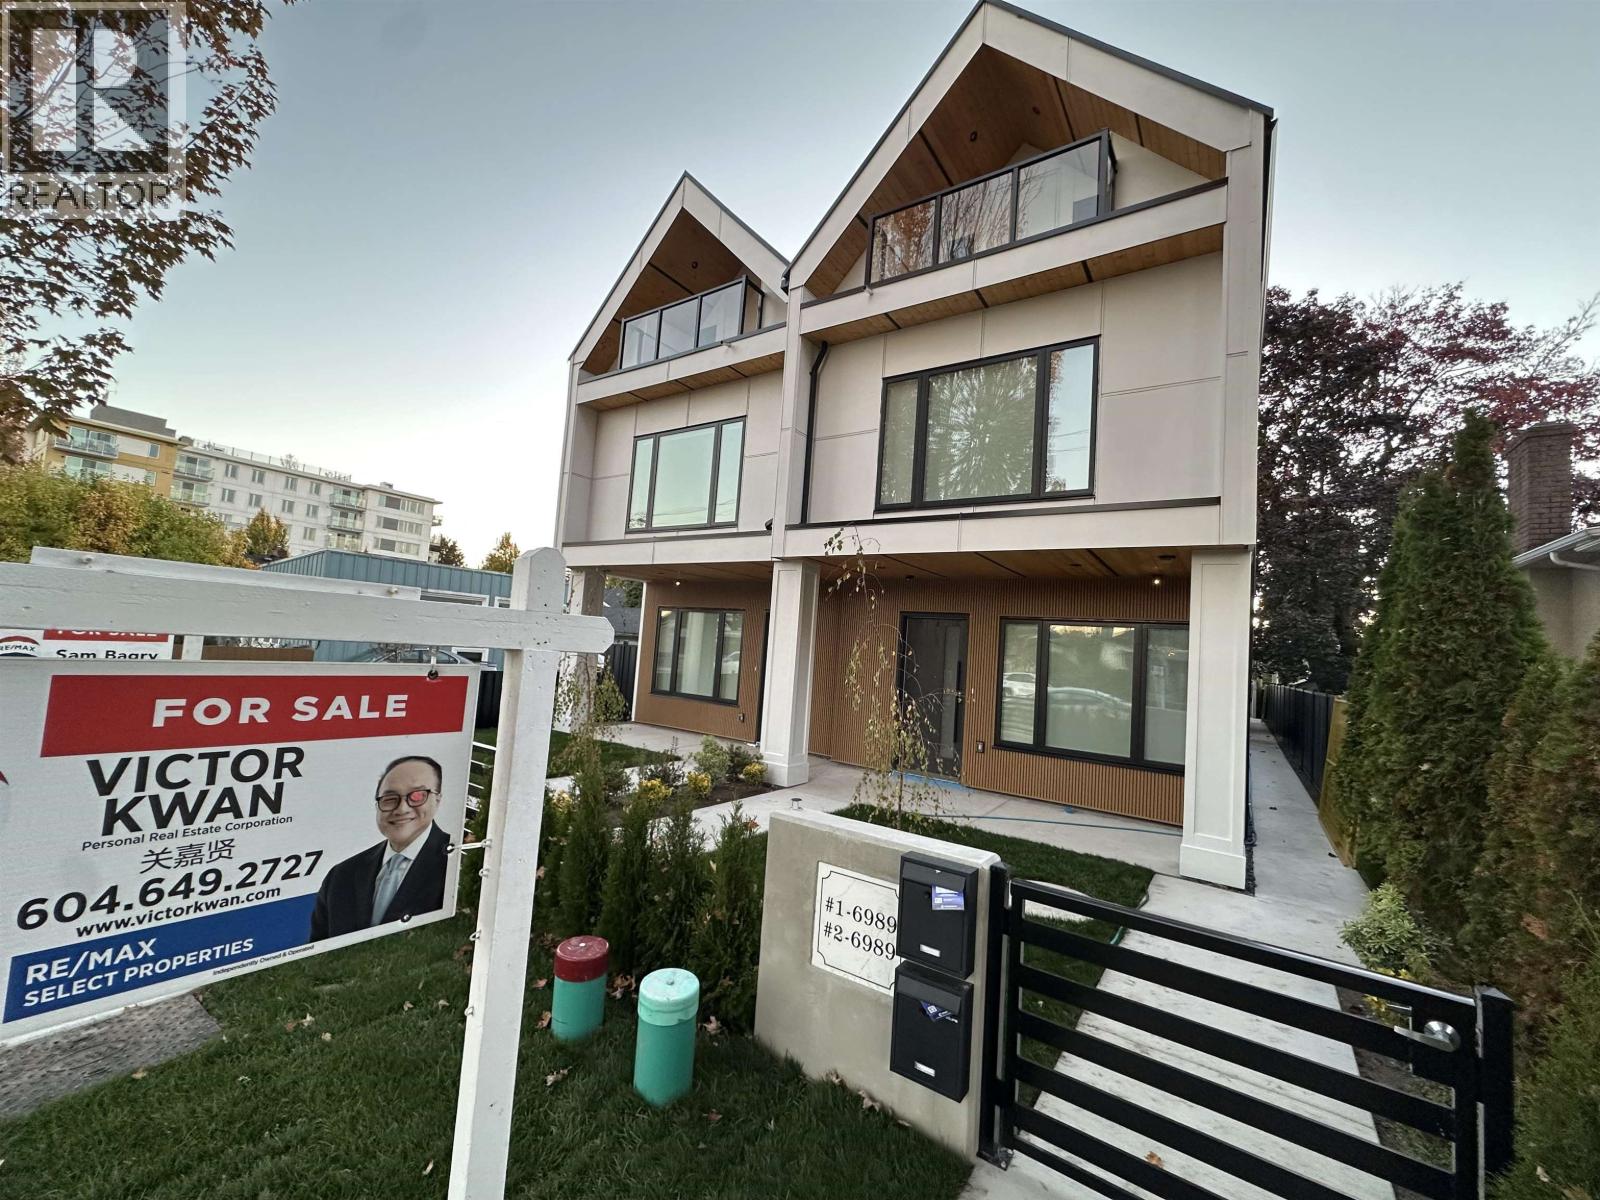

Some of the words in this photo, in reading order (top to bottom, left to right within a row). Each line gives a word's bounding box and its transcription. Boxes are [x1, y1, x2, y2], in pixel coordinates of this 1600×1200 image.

[152, 697, 271, 728] FOR
[291, 694, 409, 722] SALE
[86, 746, 305, 797] VICTOR
[101, 782, 285, 837] KWAN
[81, 834, 145, 851] Personal
[149, 830, 179, 842] Real
[182, 825, 222, 838] Estate
[225, 815, 293, 833] Corporation
[139, 838, 236, 874] 关嘉贤
[17, 850, 324, 930] 604.649.2727
[76, 887, 281, 938] www.victorkwan.com
[825, 896, 897, 934] #1-6989
[26, 938, 157, 986] RE/MAX
[212, 960, 259, 976] Independently
[260, 953, 282, 964] Owned
[288, 944, 315, 957] Operated
[824, 921, 896, 961] #2-6989
[23, 971, 119, 1007] SELECT
[123, 938, 254, 983] PROPERTIES
